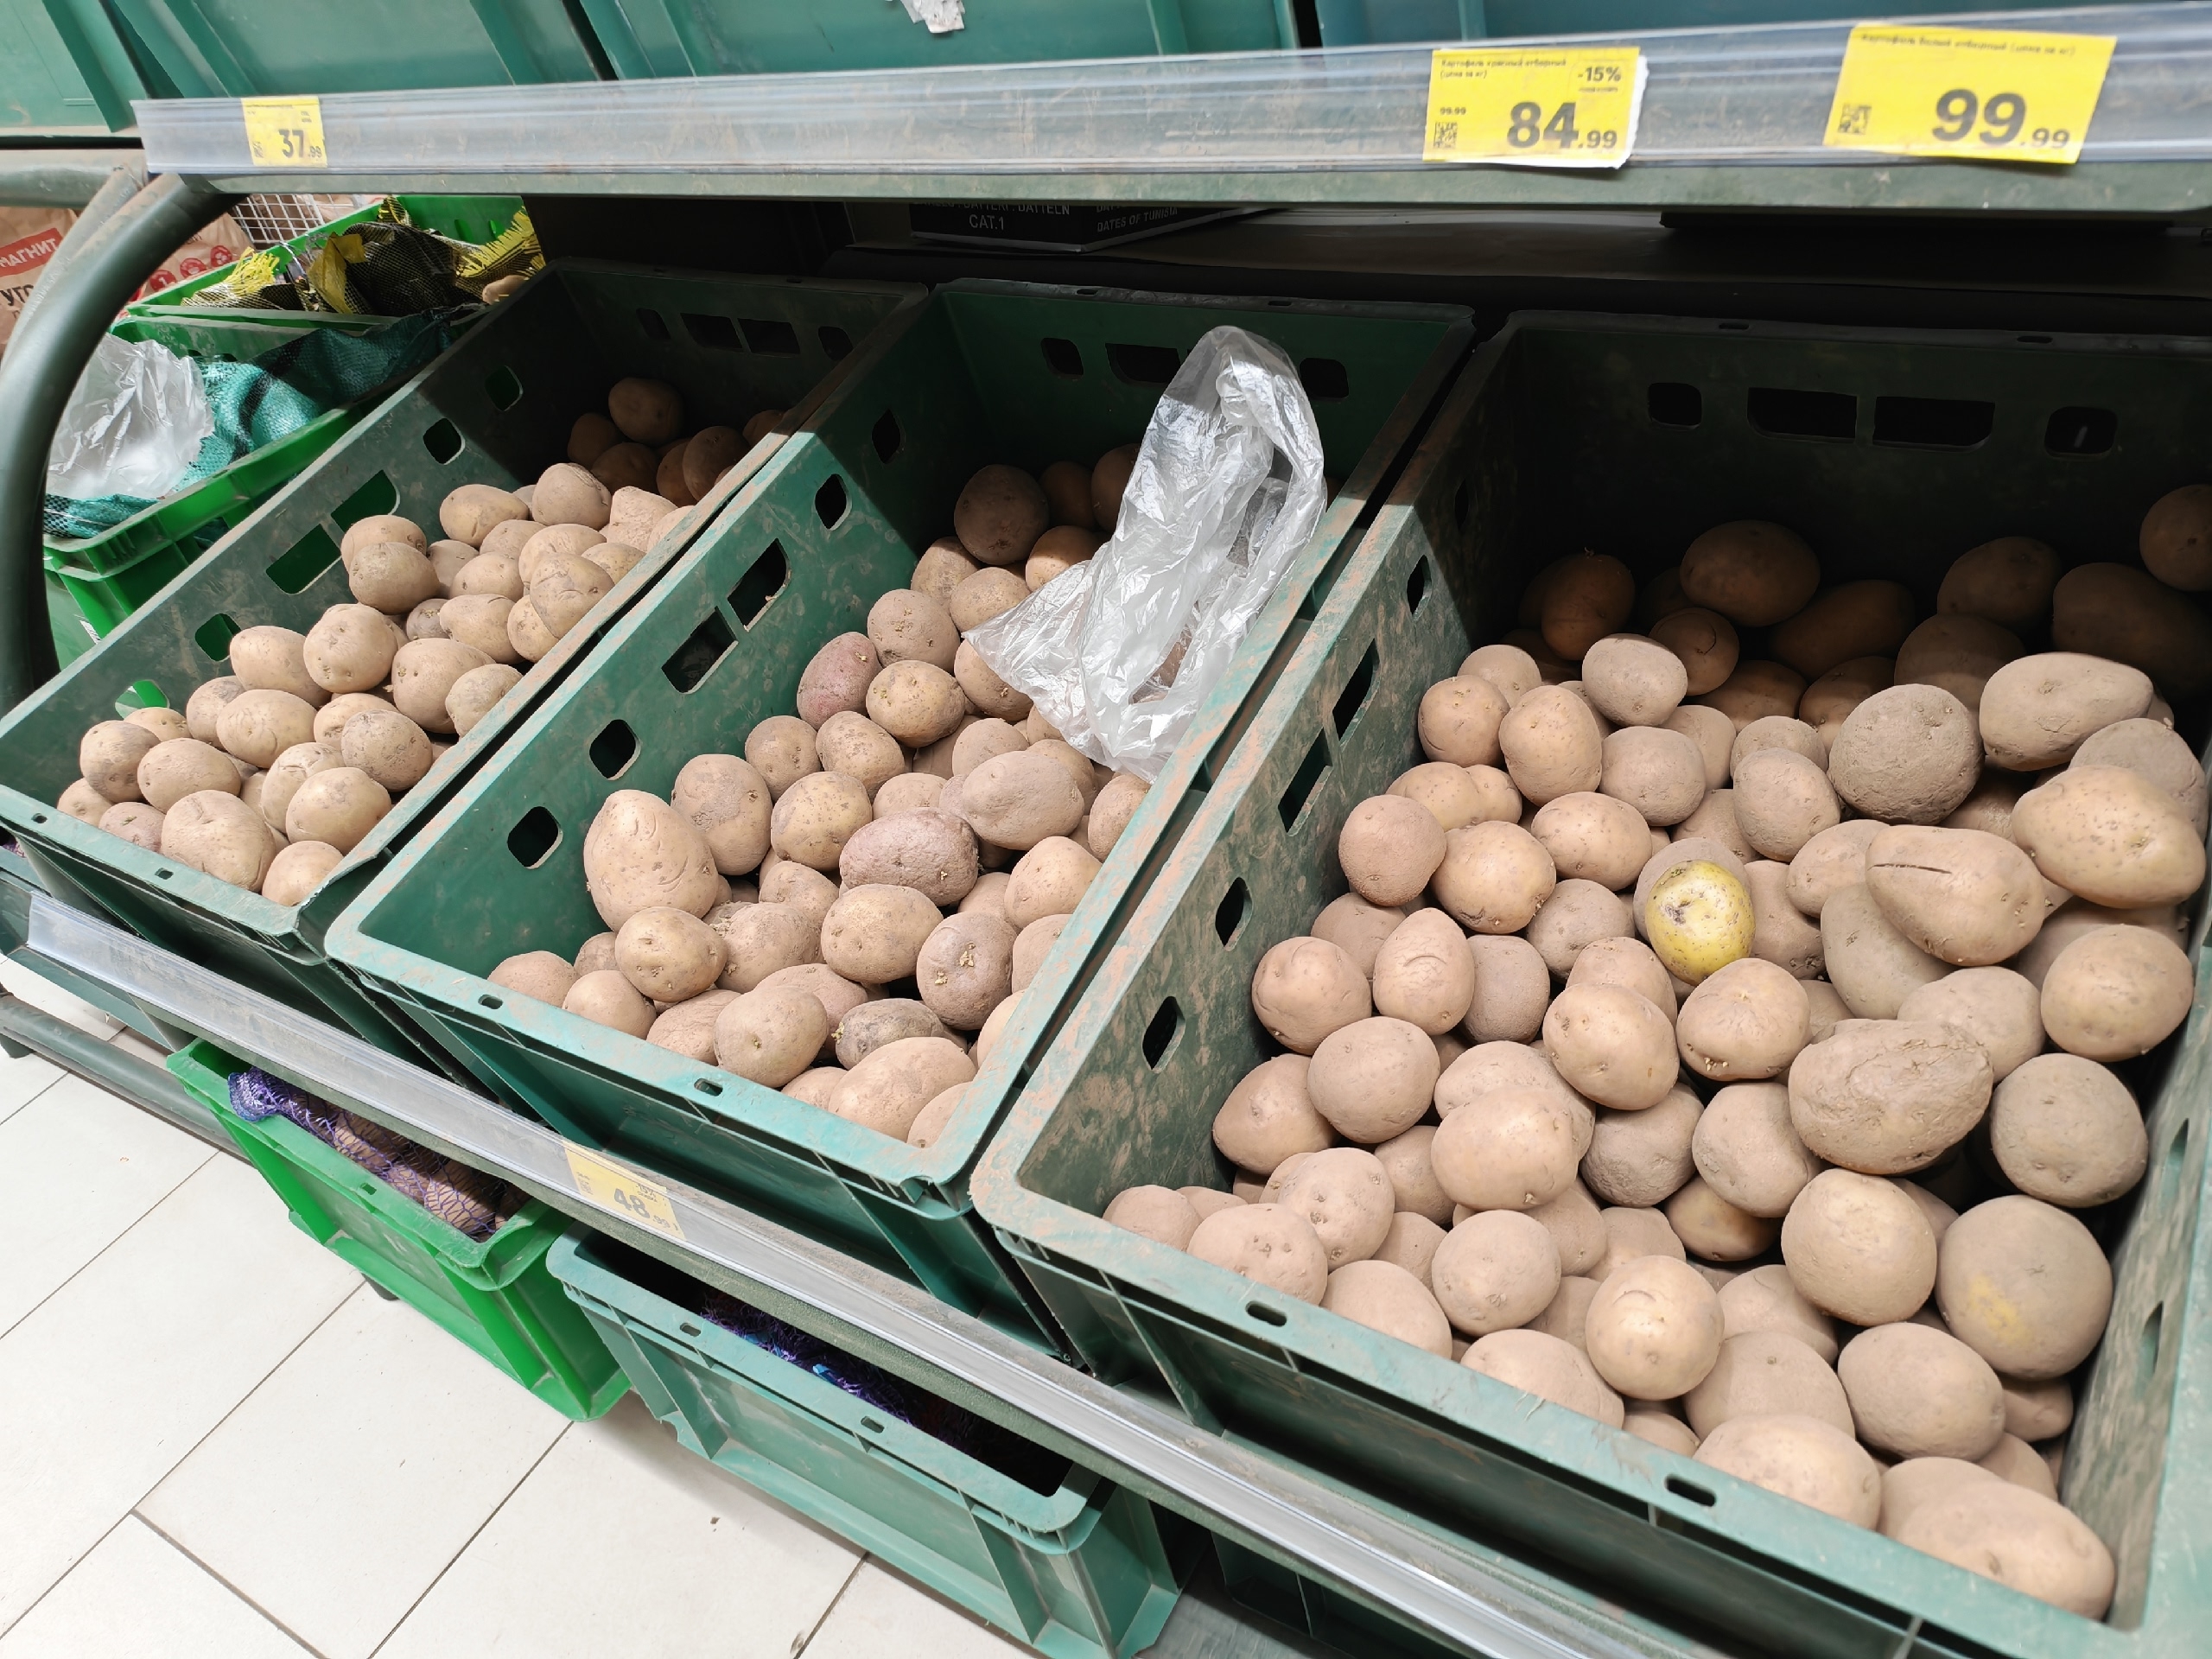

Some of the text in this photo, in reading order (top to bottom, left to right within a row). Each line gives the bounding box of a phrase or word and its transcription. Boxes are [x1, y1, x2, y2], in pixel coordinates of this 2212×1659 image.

[1577, 66, 1622, 82] -15%
[1439, 106, 1466, 116] 99.99
[1931, 88, 2071, 149] 99.99
[1507, 101, 1618, 149] 84.99
[277, 128, 322, 159] 37.99
[969, 213, 1005, 231] CAT.1
[1096, 217, 1126, 233] DATES
[1128, 213, 1141, 226] OF
